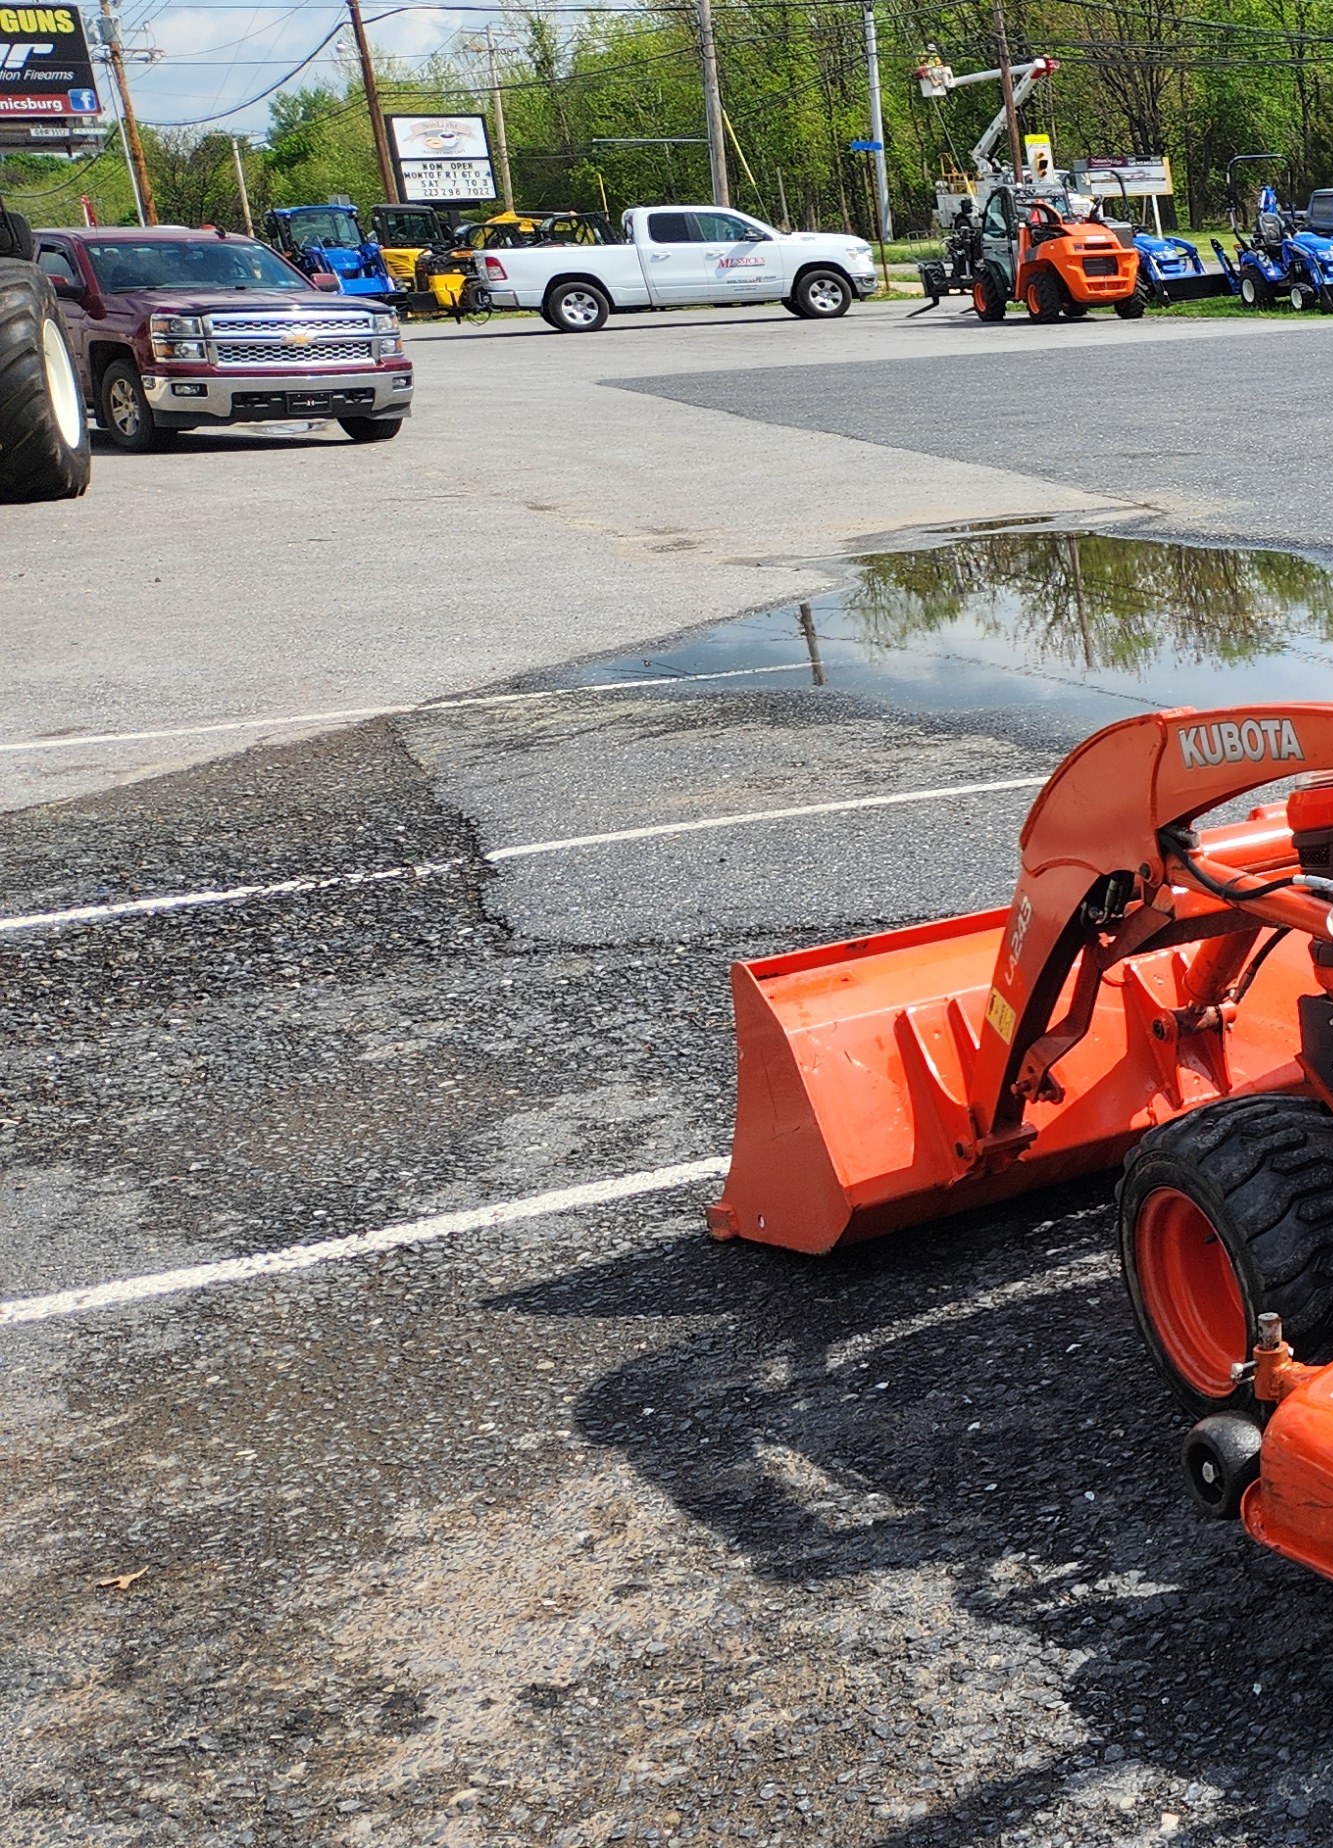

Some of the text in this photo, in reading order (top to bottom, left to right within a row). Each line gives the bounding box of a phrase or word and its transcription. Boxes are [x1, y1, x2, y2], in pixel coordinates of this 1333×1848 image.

[0, 9, 75, 33] GUNS
[23, 69, 75, 81] Firearms
[450, 162, 473, 170] OPEN
[421, 180, 439, 188] SAT
[423, 187, 490, 196] 223 298 7022
[718, 257, 766, 269] MESSICK'S
[1178, 718, 1306, 769] KUBOTA
[1004, 895, 1032, 987] LA243
